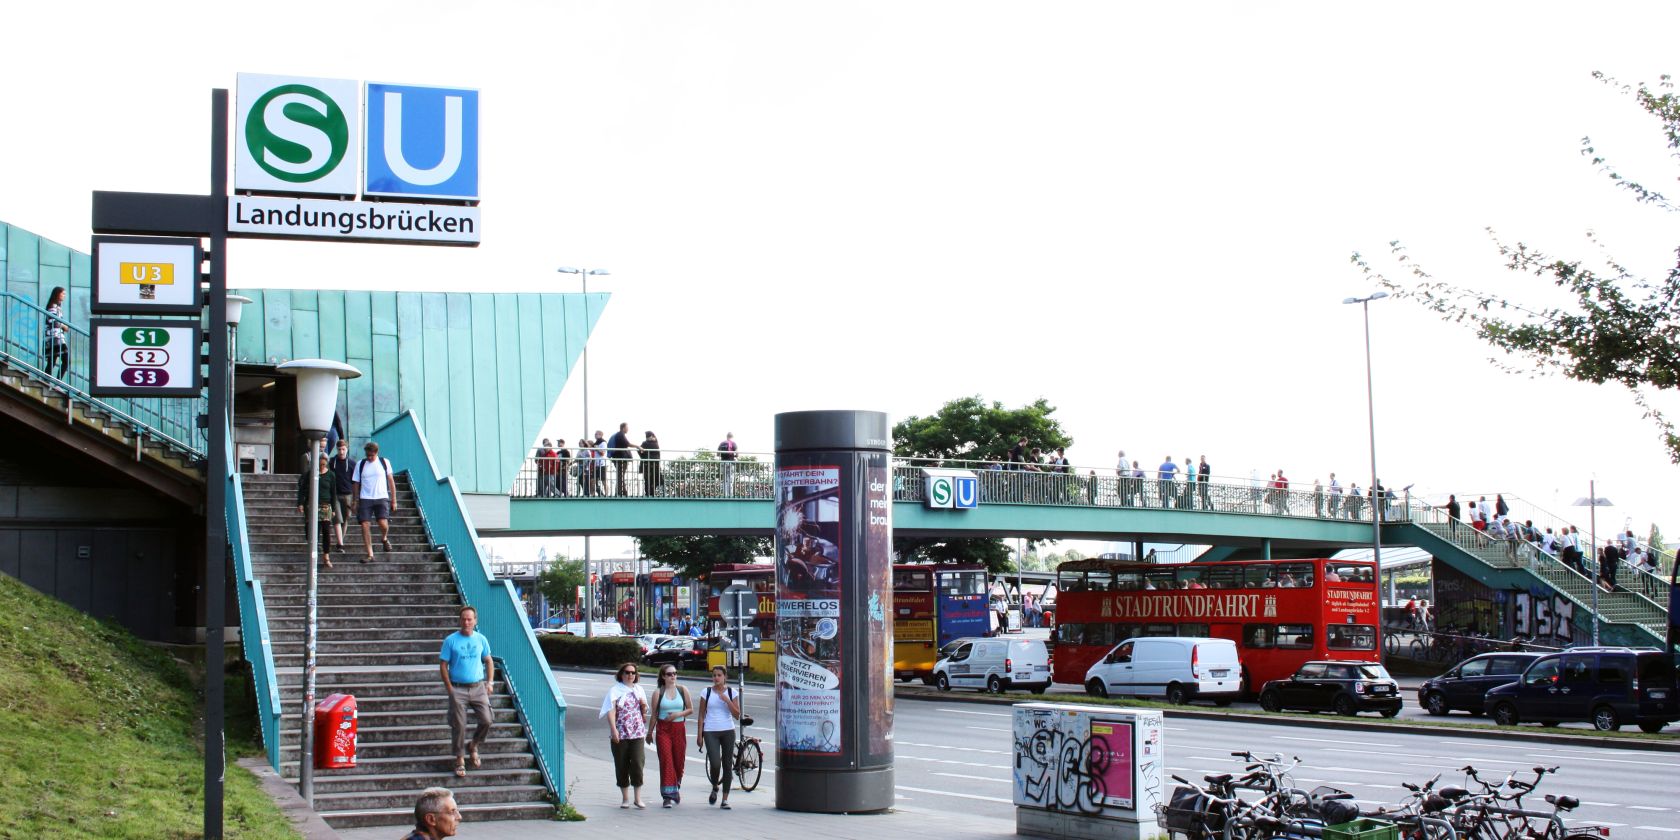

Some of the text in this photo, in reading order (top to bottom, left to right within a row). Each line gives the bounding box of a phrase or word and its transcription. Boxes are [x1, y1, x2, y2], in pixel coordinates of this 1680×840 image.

[262, 92, 463, 186] S U
[235, 202, 474, 235] Landungsbrücken
[958, 479, 975, 506] U
[1115, 594, 1260, 618] STADTRUNDFAHRT
[791, 659, 812, 670] JETZT
[1033, 719, 1047, 729] WC
